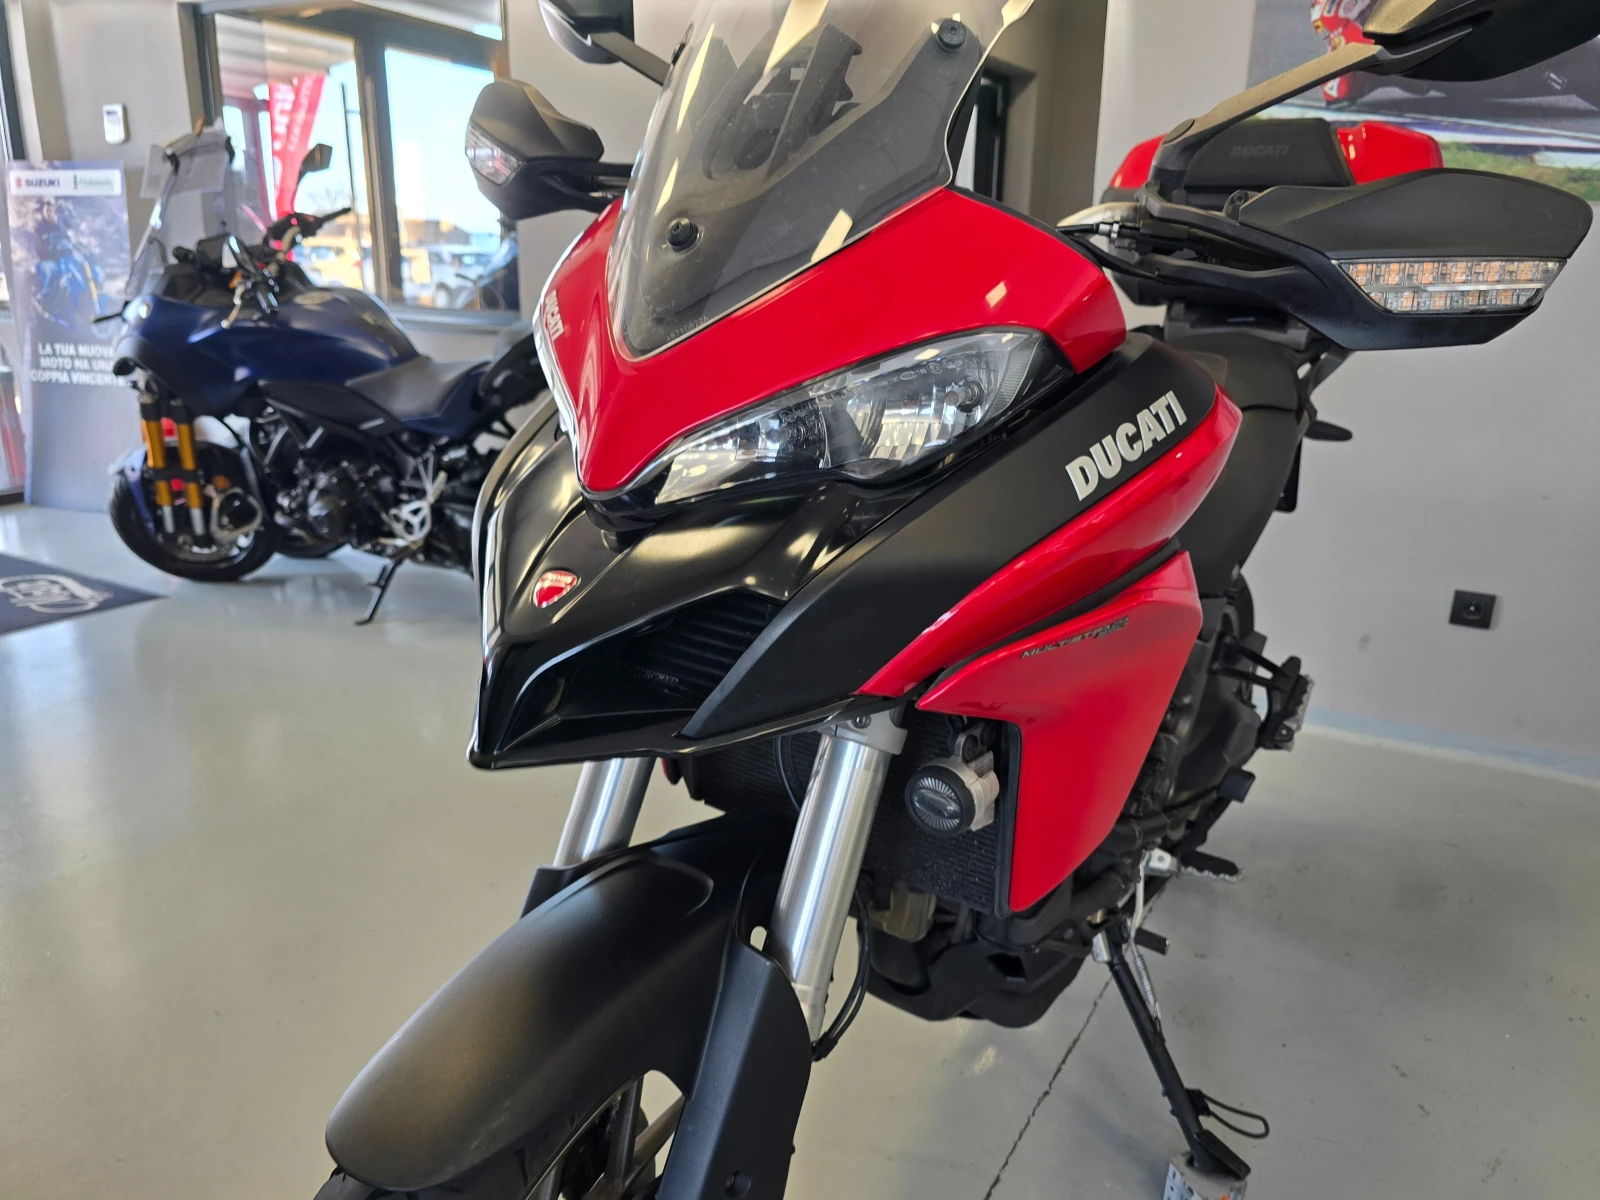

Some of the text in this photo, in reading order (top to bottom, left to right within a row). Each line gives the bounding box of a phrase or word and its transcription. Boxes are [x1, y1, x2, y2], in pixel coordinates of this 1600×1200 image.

[25, 178, 61, 187] SUZUKI
[38, 342, 115, 358] LA TUA NUOVA
[41, 356, 73, 370] MOTO
[1065, 390, 1187, 501] DUCATI
